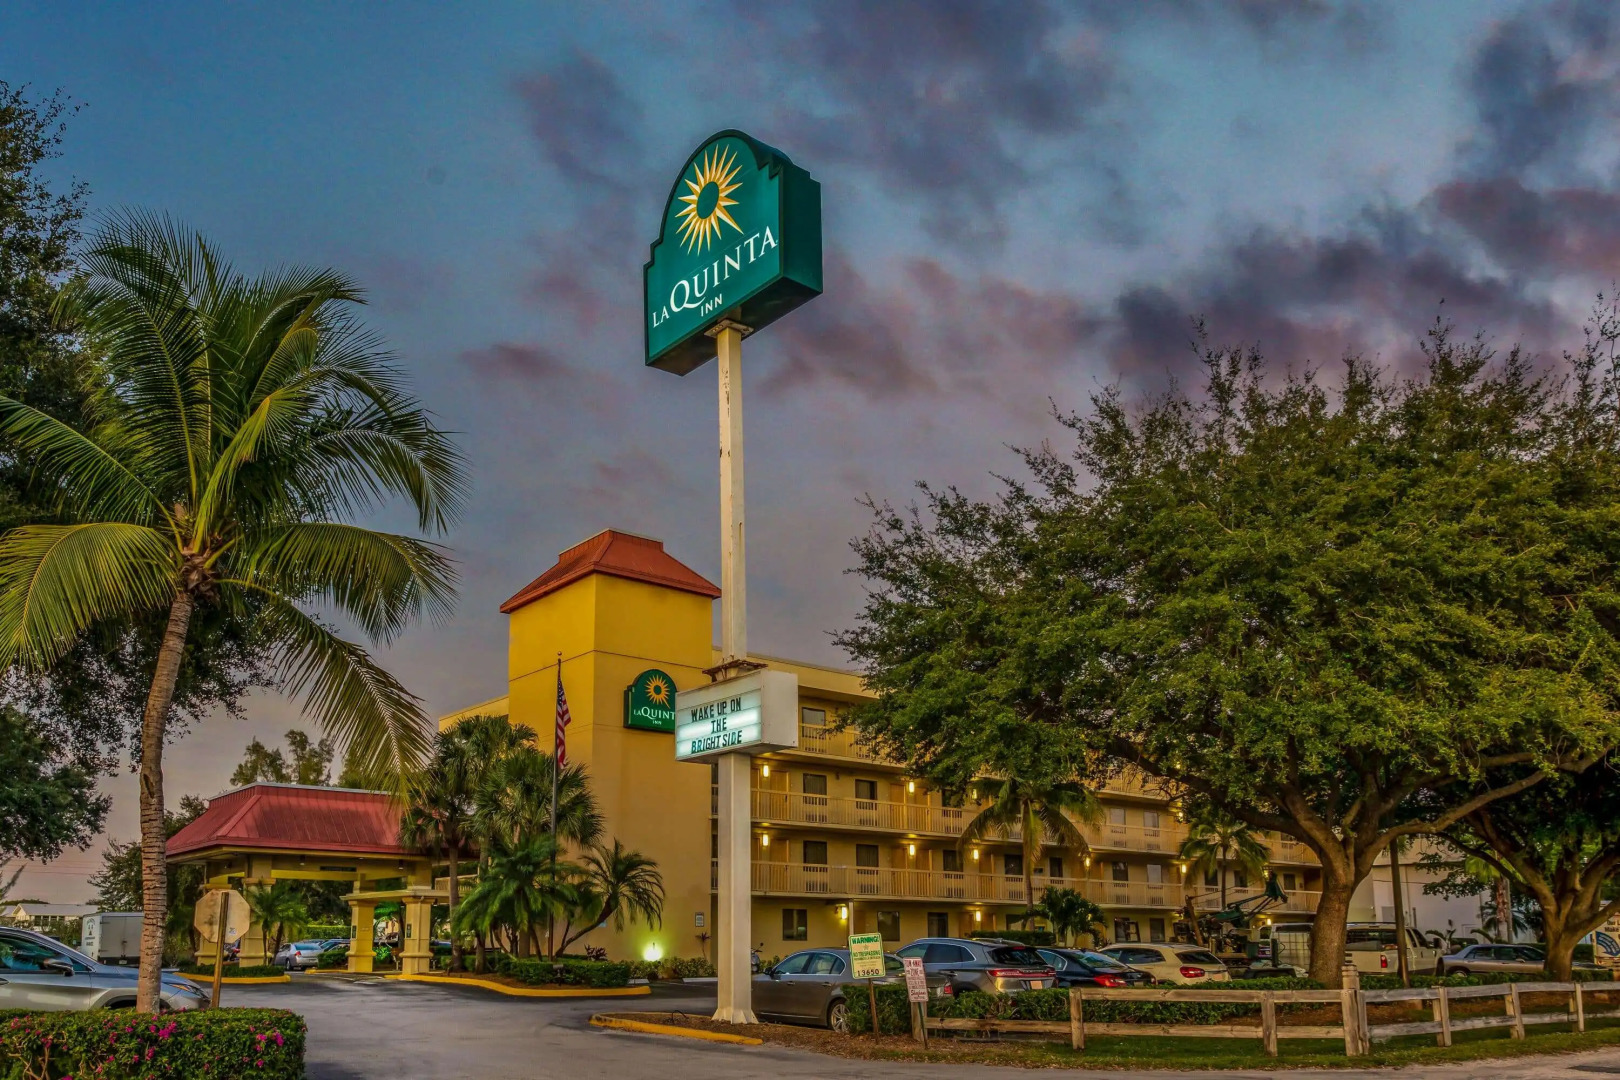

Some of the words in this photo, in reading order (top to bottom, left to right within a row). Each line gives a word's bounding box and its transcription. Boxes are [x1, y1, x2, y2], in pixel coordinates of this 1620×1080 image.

[653, 305, 669, 328] LA
[670, 225, 777, 312] QUINTA
[700, 293, 723, 317] INN
[641, 706, 676, 720] QUINT
[691, 704, 715, 723] WAKE
[717, 700, 727, 716] UP
[730, 696, 741, 712] ON
[711, 717, 727, 734] THE
[691, 735, 721, 754] BRIGHT
[722, 730, 742, 747] SIDE
[857, 969, 879, 977] 13650
